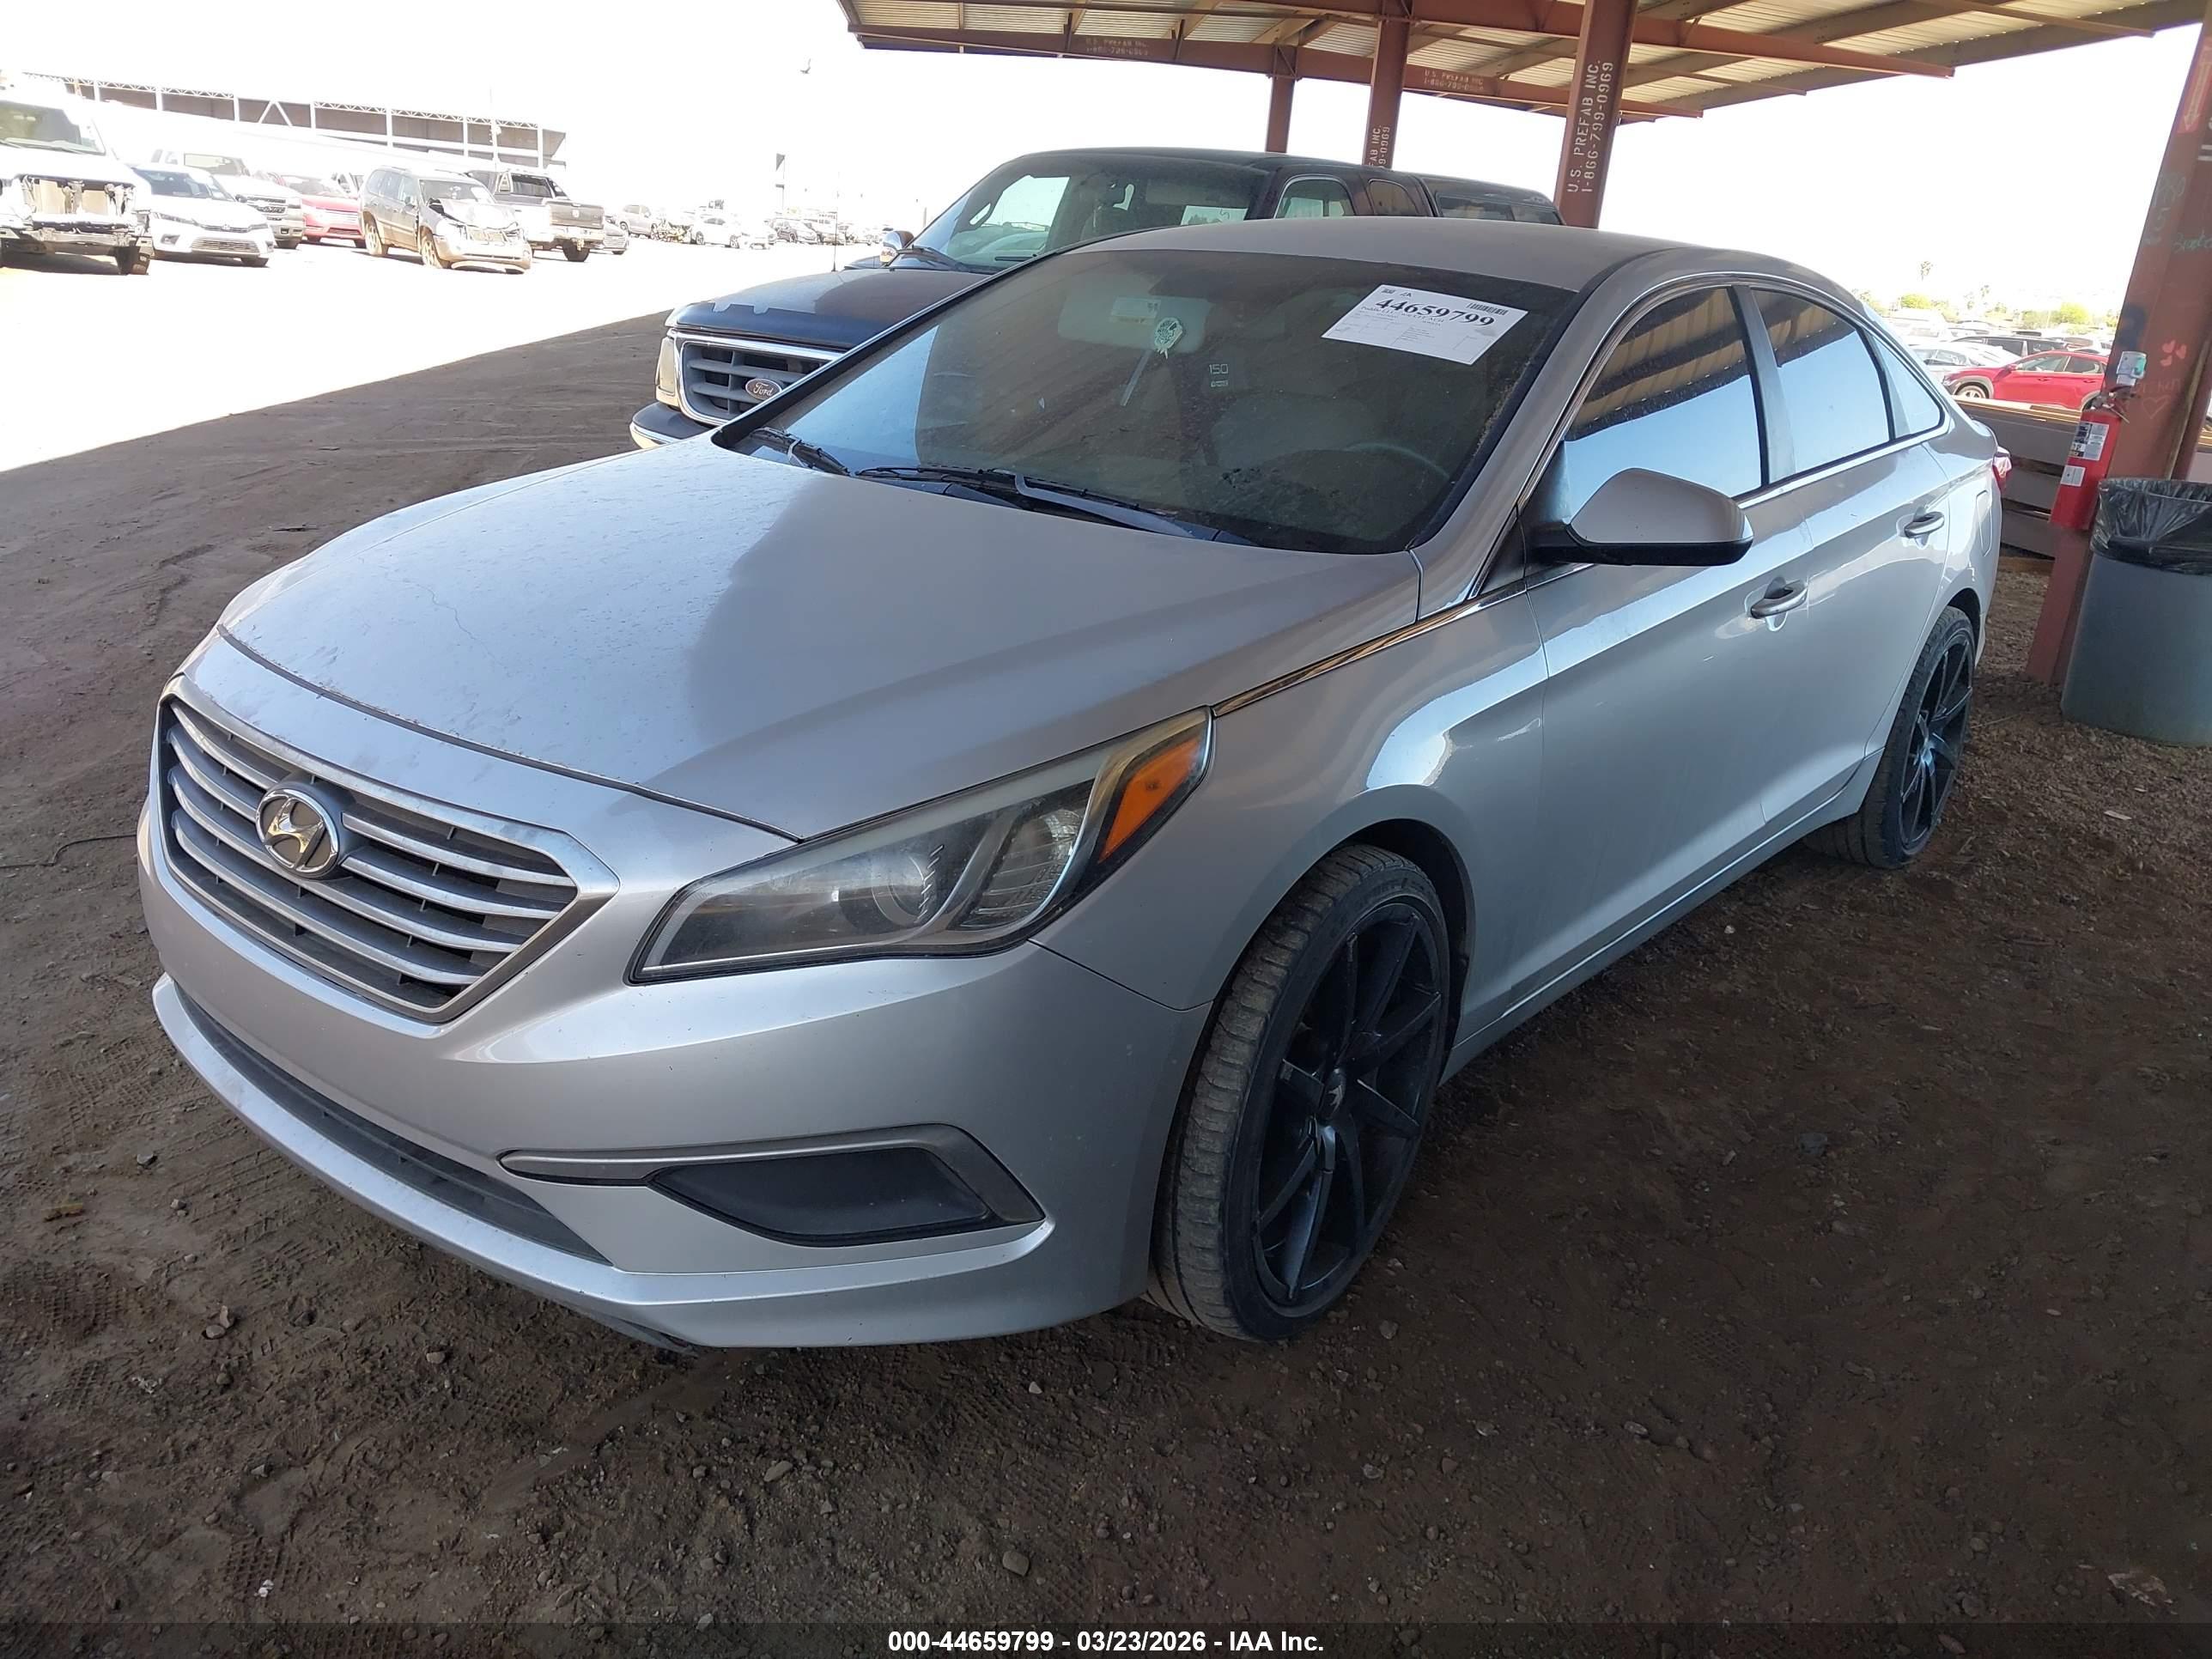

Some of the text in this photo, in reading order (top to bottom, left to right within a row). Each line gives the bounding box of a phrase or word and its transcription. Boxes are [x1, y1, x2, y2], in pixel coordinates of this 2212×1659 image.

[1371, 125, 1382, 144] INC.
[1567, 60, 1601, 193] U.S. PREFAB INC.
[1581, 62, 1614, 193] 1-866-799-0969
[1376, 298, 1496, 327] 44659799
[753, 381, 775, 397] Ford
